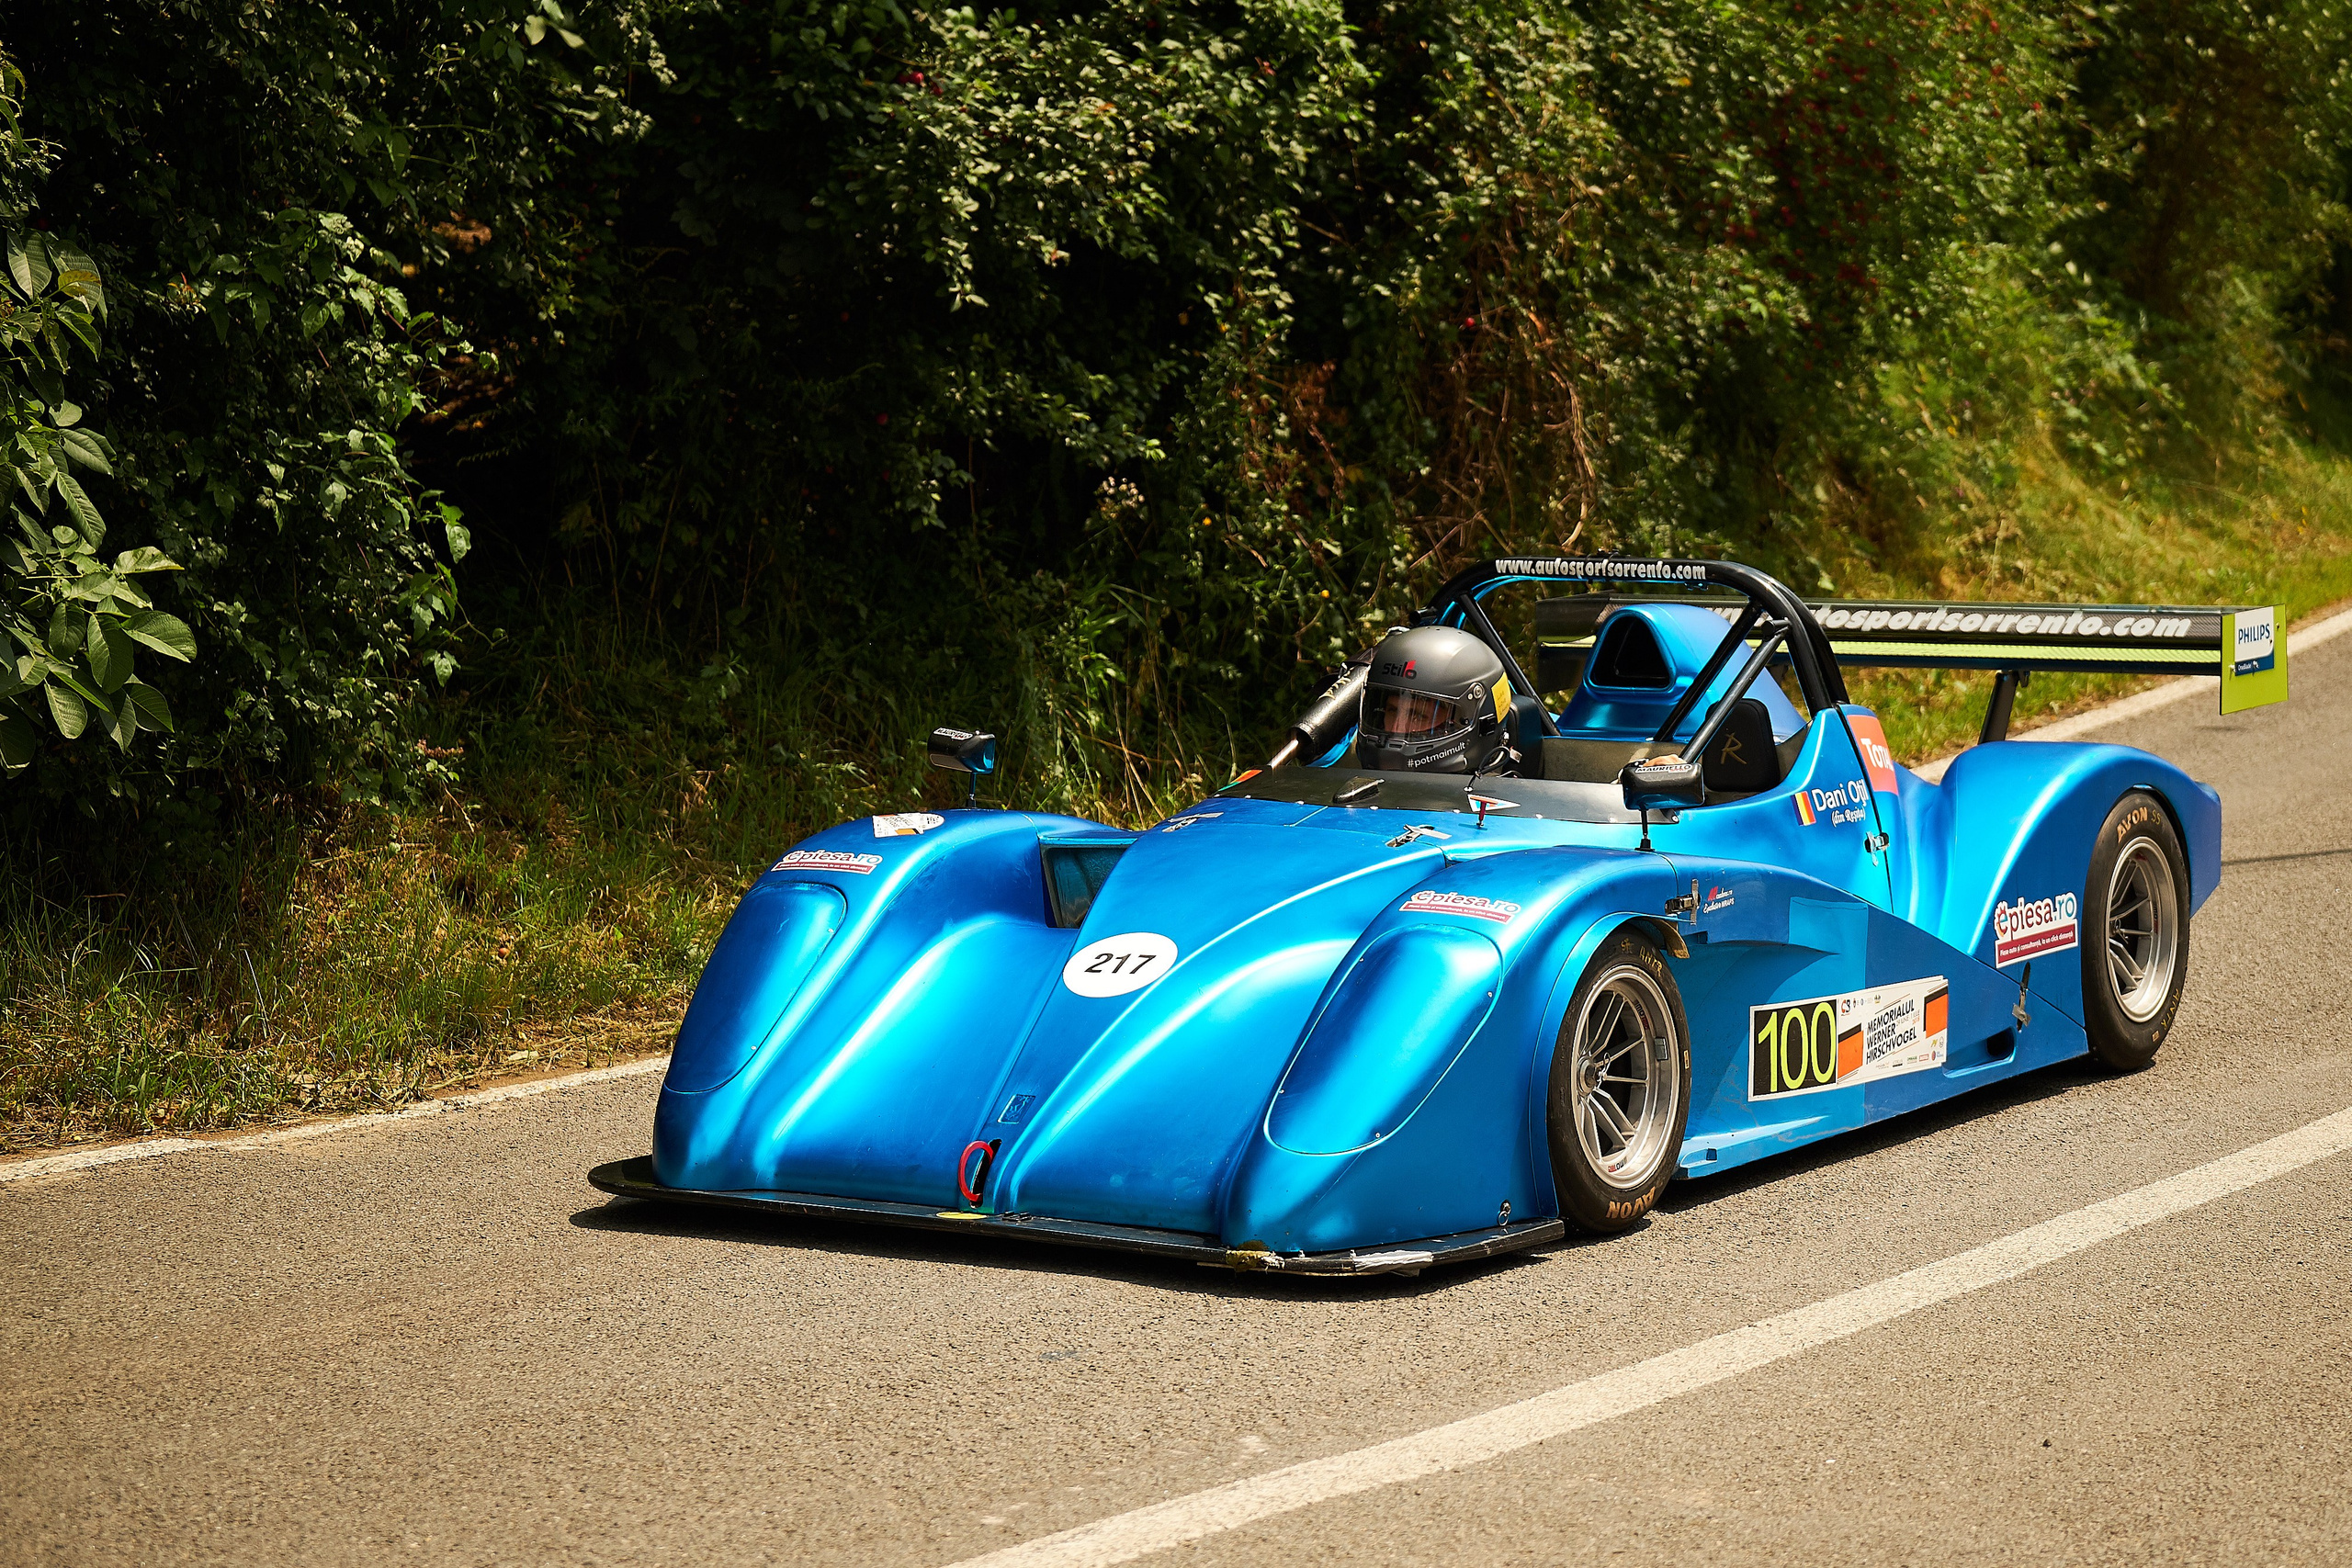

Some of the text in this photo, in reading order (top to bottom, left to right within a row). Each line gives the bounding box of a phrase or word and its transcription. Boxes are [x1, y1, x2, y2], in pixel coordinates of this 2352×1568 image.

[1495, 558, 1707, 581] www.autosportsorrento.com
[1808, 604, 2190, 638] tosportsorrento.com
[2237, 623, 2271, 645] PHILIPS
[1407, 741, 1466, 769] #potmaimult
[1811, 783, 1849, 812] Dani
[2116, 807, 2148, 843] AVON
[1996, 897, 2075, 941] epiesa.ro
[1084, 953, 1157, 975] 217
[1866, 998, 1916, 1036] MEMORIALUL
[1758, 1001, 1837, 1093] 100
[1866, 1022, 1896, 1050] WERNER
[1866, 1026, 1917, 1066] HIRSCHVOGEL
[1605, 1186, 1656, 1220] AVON
